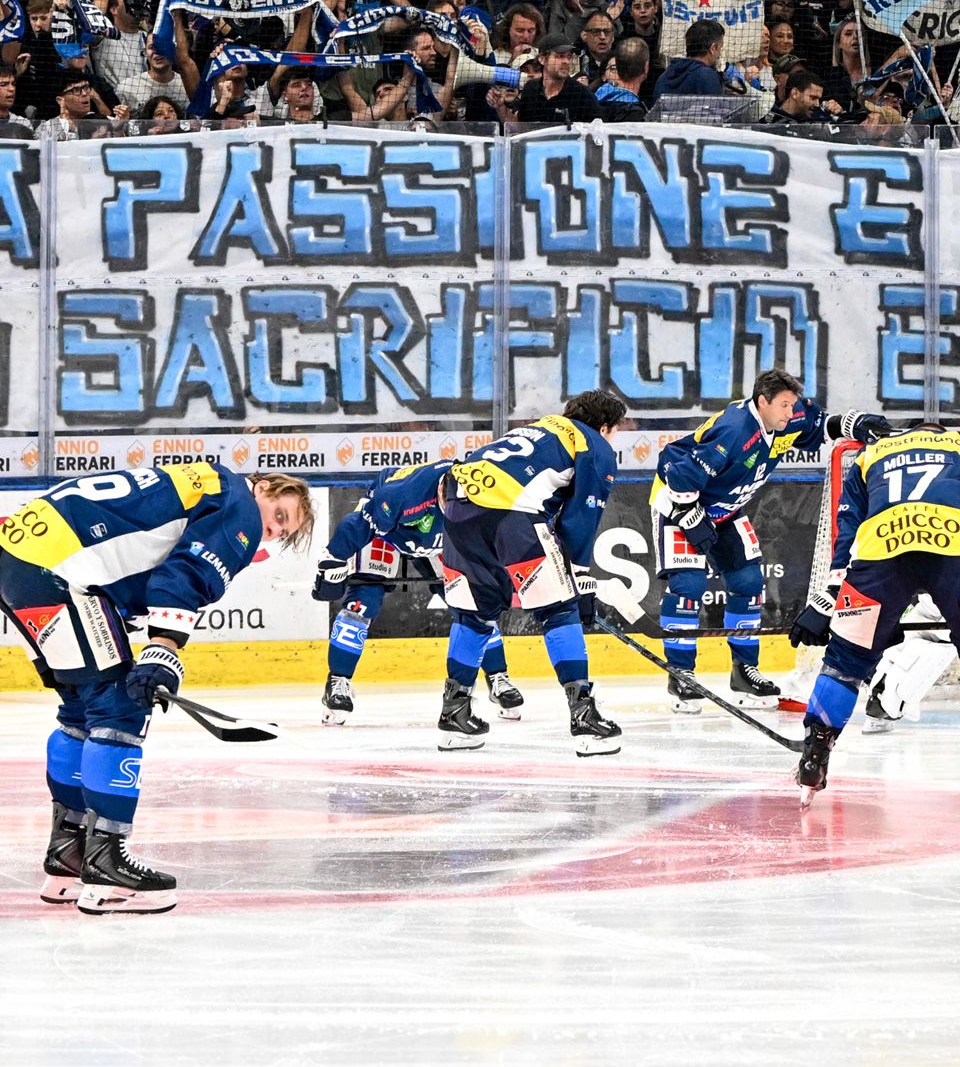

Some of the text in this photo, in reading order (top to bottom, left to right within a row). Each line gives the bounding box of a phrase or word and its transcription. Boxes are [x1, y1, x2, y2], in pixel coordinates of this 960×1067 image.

[101, 137, 789, 270] PASSIONE
[828, 150, 925, 266] E
[56, 277, 829, 426] SACRIFICIO
[56, 440, 100, 454] NNIO
[153, 438, 205, 453] ENNIO
[257, 437, 309, 452] ENNIO
[361, 436, 413, 450] ENNIO
[54, 456, 115, 471] ERRARI
[257, 452, 325, 468] FERRARI
[883, 464, 945, 503] 17
[876, 513, 960, 538] CHICCO
[885, 530, 951, 554] D'ORO
[673, 556, 693, 564] Studio
[193, 607, 265, 631] zona
[97, 620, 117, 660] SOBRINOS
